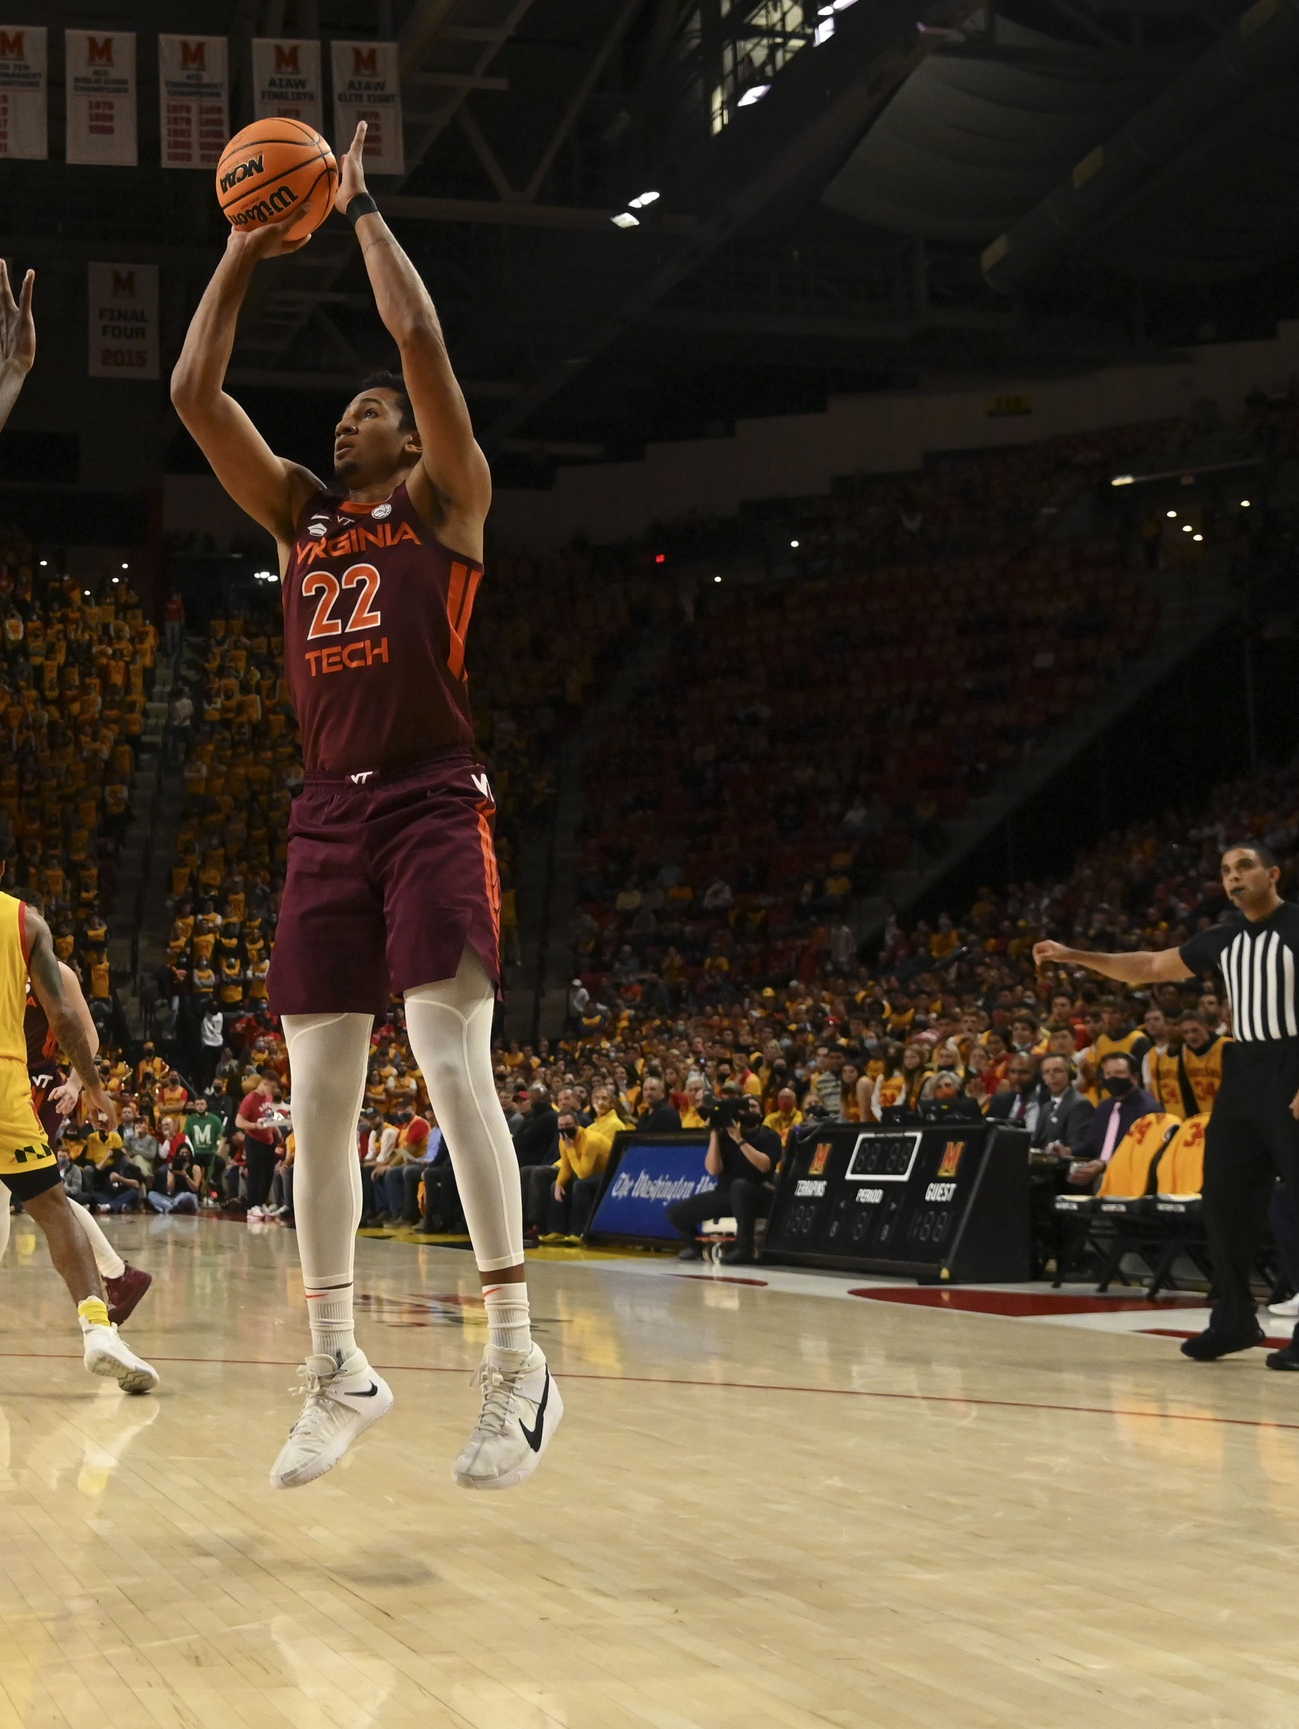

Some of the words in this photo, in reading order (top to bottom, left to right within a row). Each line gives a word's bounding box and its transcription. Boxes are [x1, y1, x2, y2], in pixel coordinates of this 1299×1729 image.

[0, 31, 25, 60] M
[87, 37, 114, 67] M
[180, 41, 206, 70] M
[273, 45, 300, 73] M
[352, 48, 378, 76] M
[268, 79, 306, 89] AIAW
[347, 82, 386, 92] AIAW
[220, 155, 264, 194] NCAA
[229, 185, 299, 224] Wilson
[112, 270, 136, 299] M
[99, 308, 148, 322] FINAL
[102, 325, 146, 339] FOUR
[302, 563, 381, 641] 22
[304, 636, 390, 677] TECH
[351, 770, 374, 785] VT
[31, 1073, 55, 1089] VT
[193, 1123, 212, 1145] M
[611, 1172, 634, 1200] The
[631, 1168, 696, 1206] Washington
[794, 1180, 828, 1197] TERRAPINS
[855, 1188, 884, 1203] PERIOD
[925, 1183, 957, 1202] GUEST
